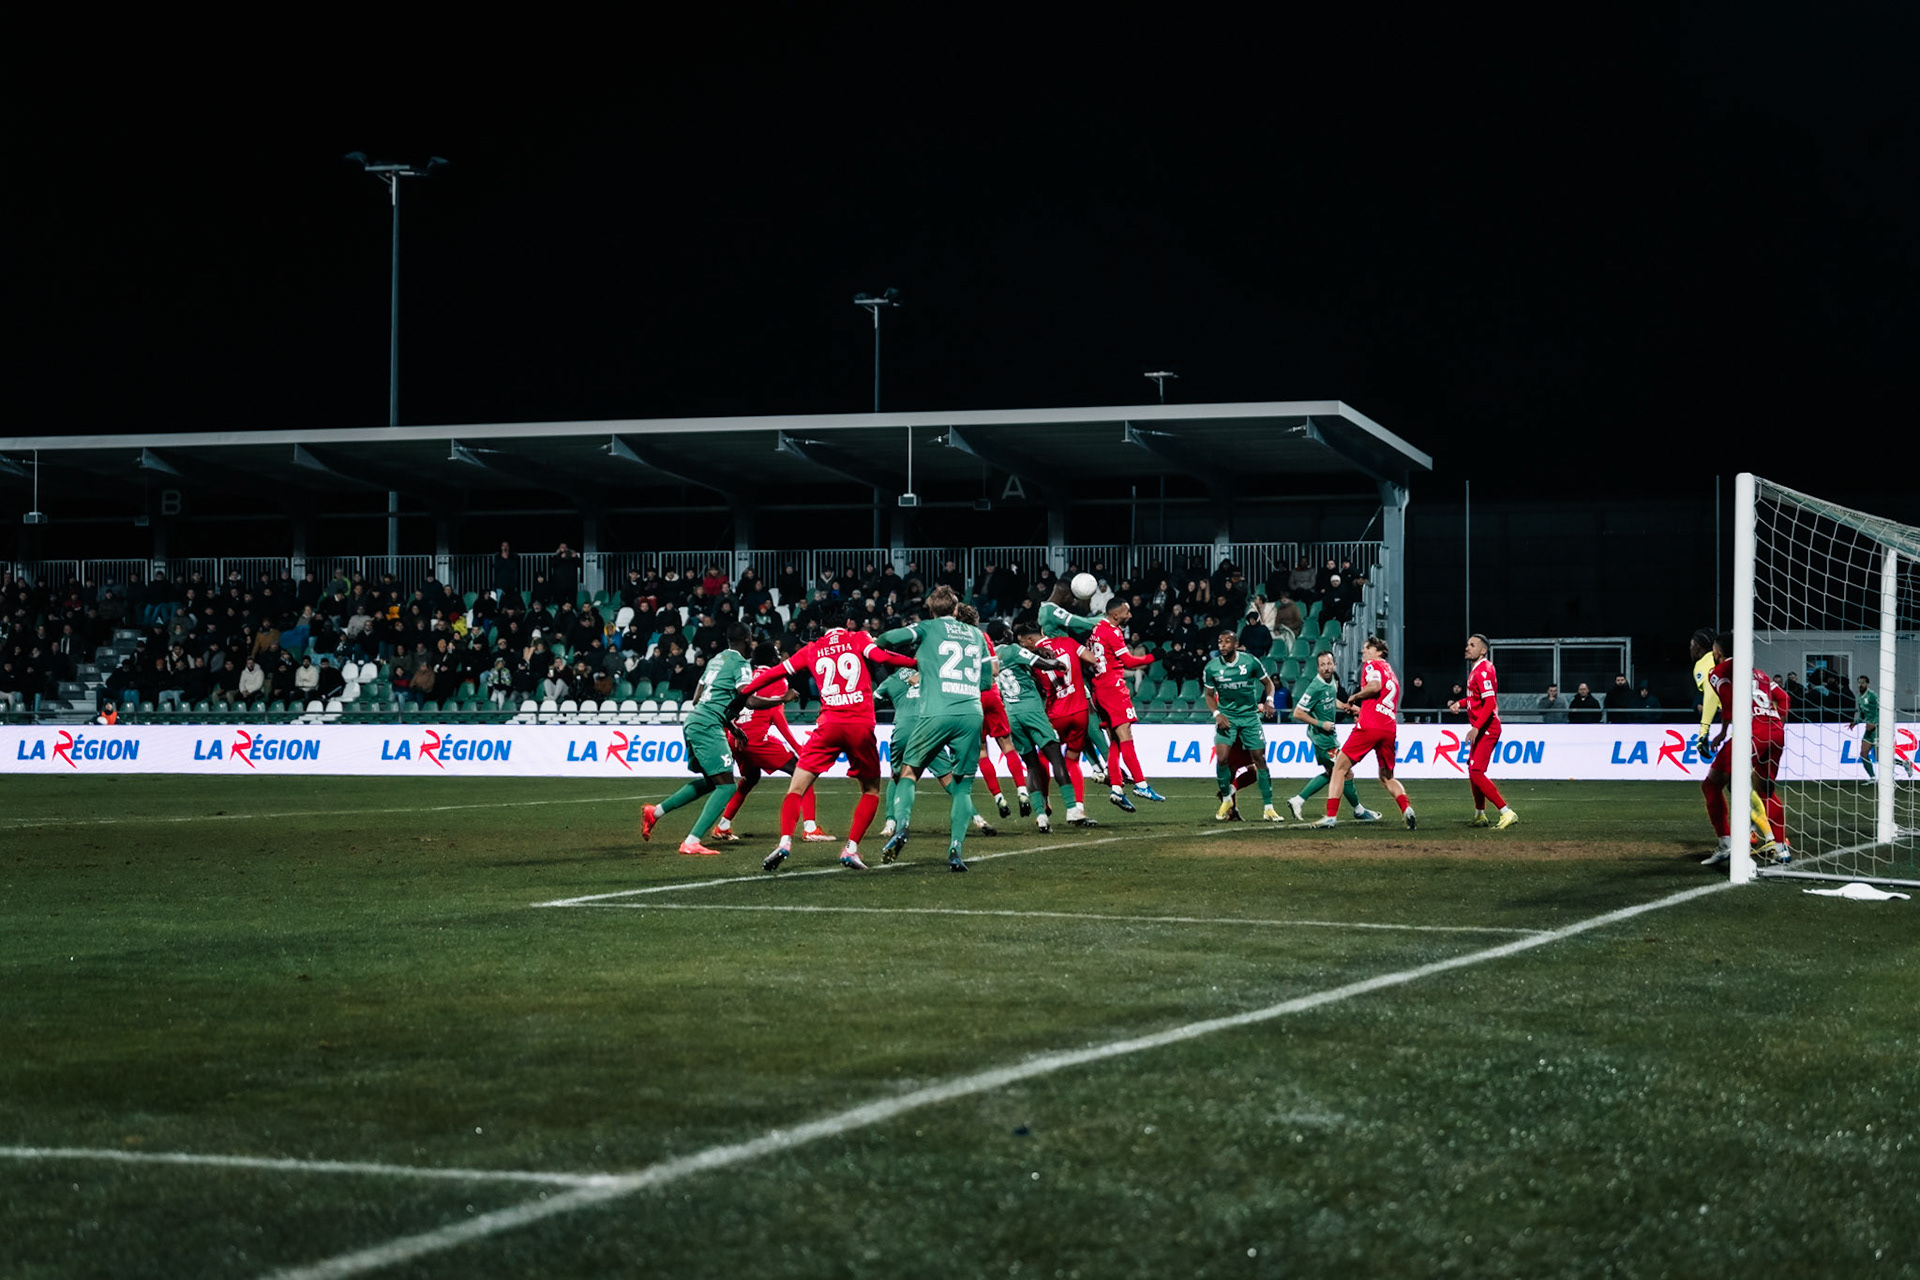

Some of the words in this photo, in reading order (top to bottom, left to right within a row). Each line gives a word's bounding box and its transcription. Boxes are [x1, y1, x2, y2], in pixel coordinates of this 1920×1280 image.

[1002, 475, 1025, 499] A
[162, 490, 181, 515] B
[817, 643, 852, 657] HESTIA
[939, 640, 981, 683] 23
[815, 652, 861, 696] 29
[1382, 680, 1397, 711] 2
[17, 740, 45, 761] LA
[52, 730, 140, 769] RÉGION
[193, 740, 223, 761] LA
[230, 730, 320, 769] RÉGION
[380, 740, 411, 761] LA
[419, 730, 512, 769] RÉGION
[566, 741, 598, 762] LA
[1166, 741, 1201, 763] LA
[1611, 741, 1648, 764] LA
